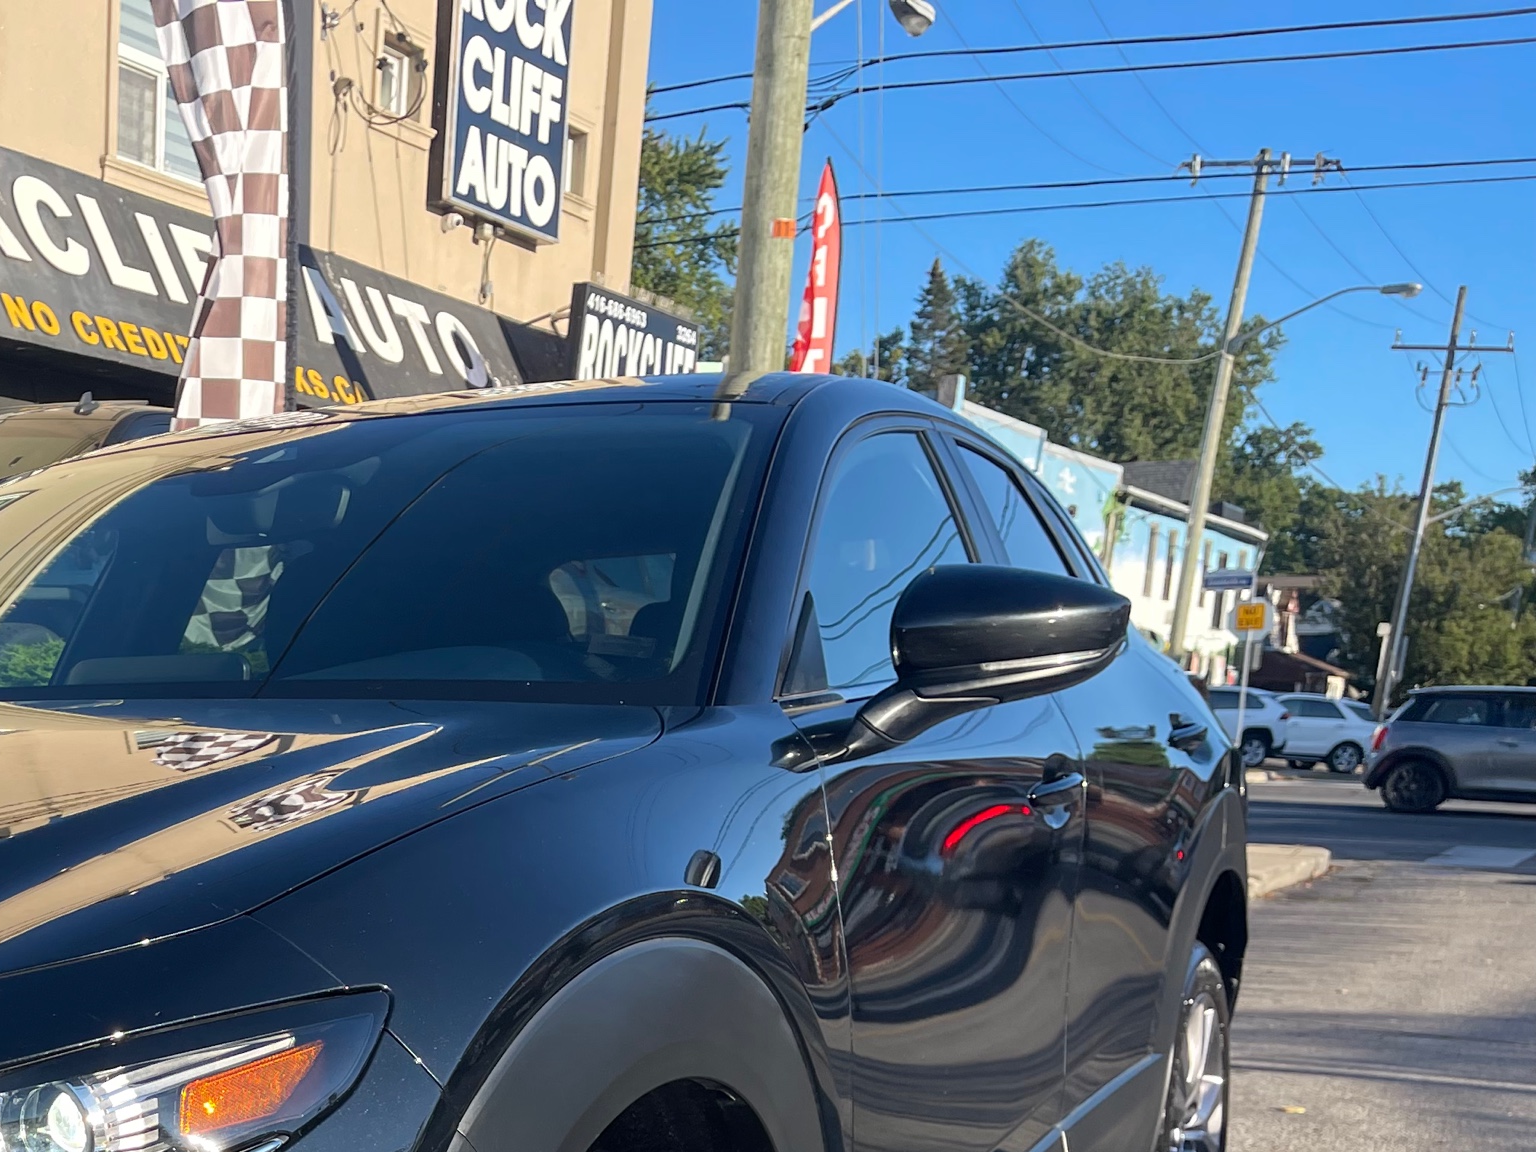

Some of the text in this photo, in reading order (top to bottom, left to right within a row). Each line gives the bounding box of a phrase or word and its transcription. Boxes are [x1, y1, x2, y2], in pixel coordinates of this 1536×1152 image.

[462, 0, 568, 66] CK
[462, 35, 564, 145] CLIFF
[455, 124, 557, 227] AUTO
[0, 292, 61, 336] NO
[300, 264, 490, 390] AUTO
